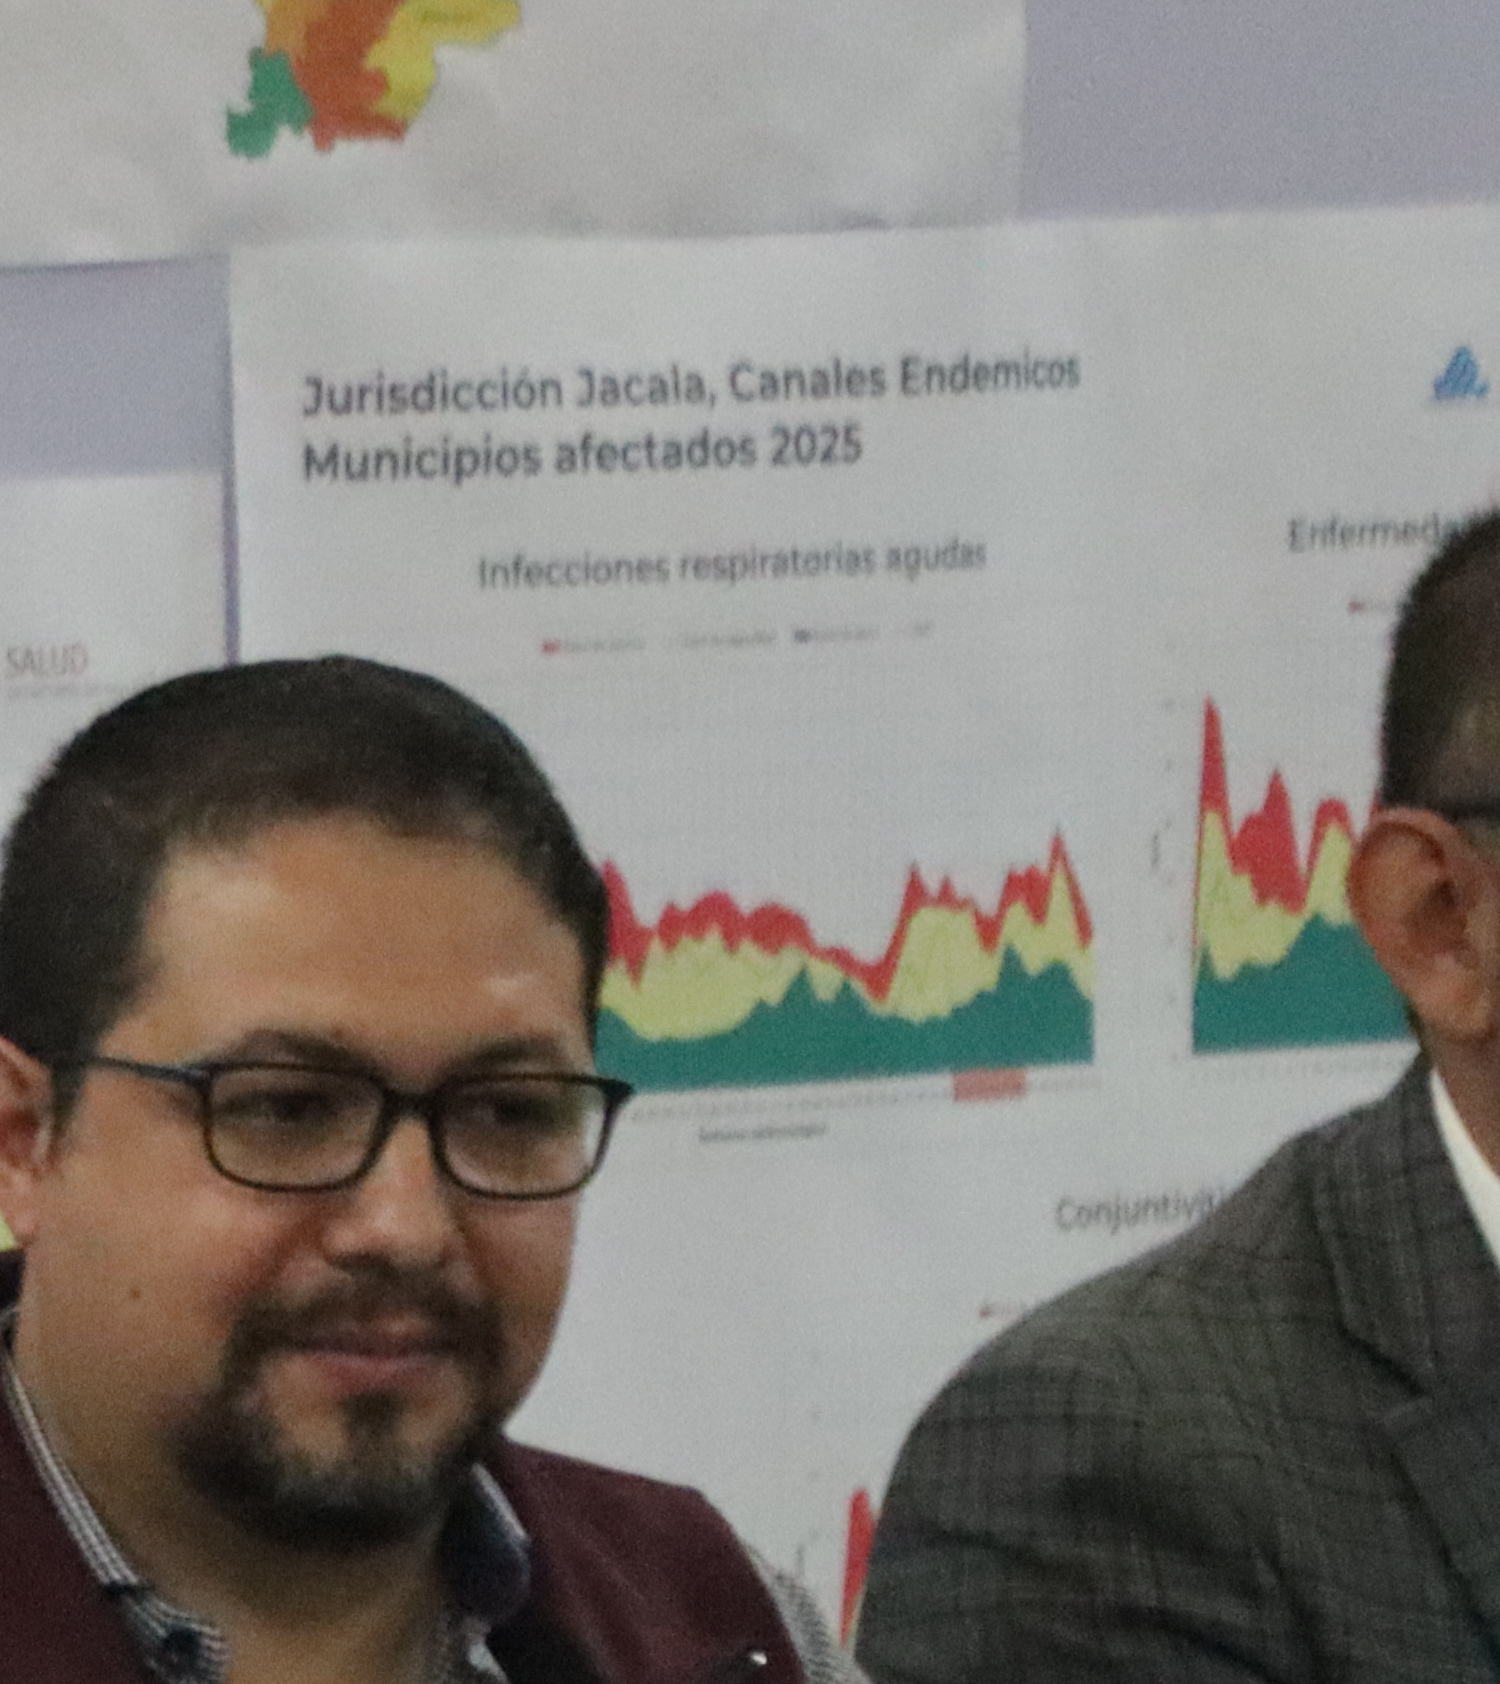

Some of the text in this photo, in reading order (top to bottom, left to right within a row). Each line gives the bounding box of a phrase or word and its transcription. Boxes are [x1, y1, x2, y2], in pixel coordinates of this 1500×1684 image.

[302, 348, 1082, 420] Jurisdicción Jacala, Canales Endemicos
[303, 425, 863, 486] Municipios afectados 2025
[478, 537, 988, 592] Infecciones respiratorias agudas
[4, 642, 90, 682] SALUD
